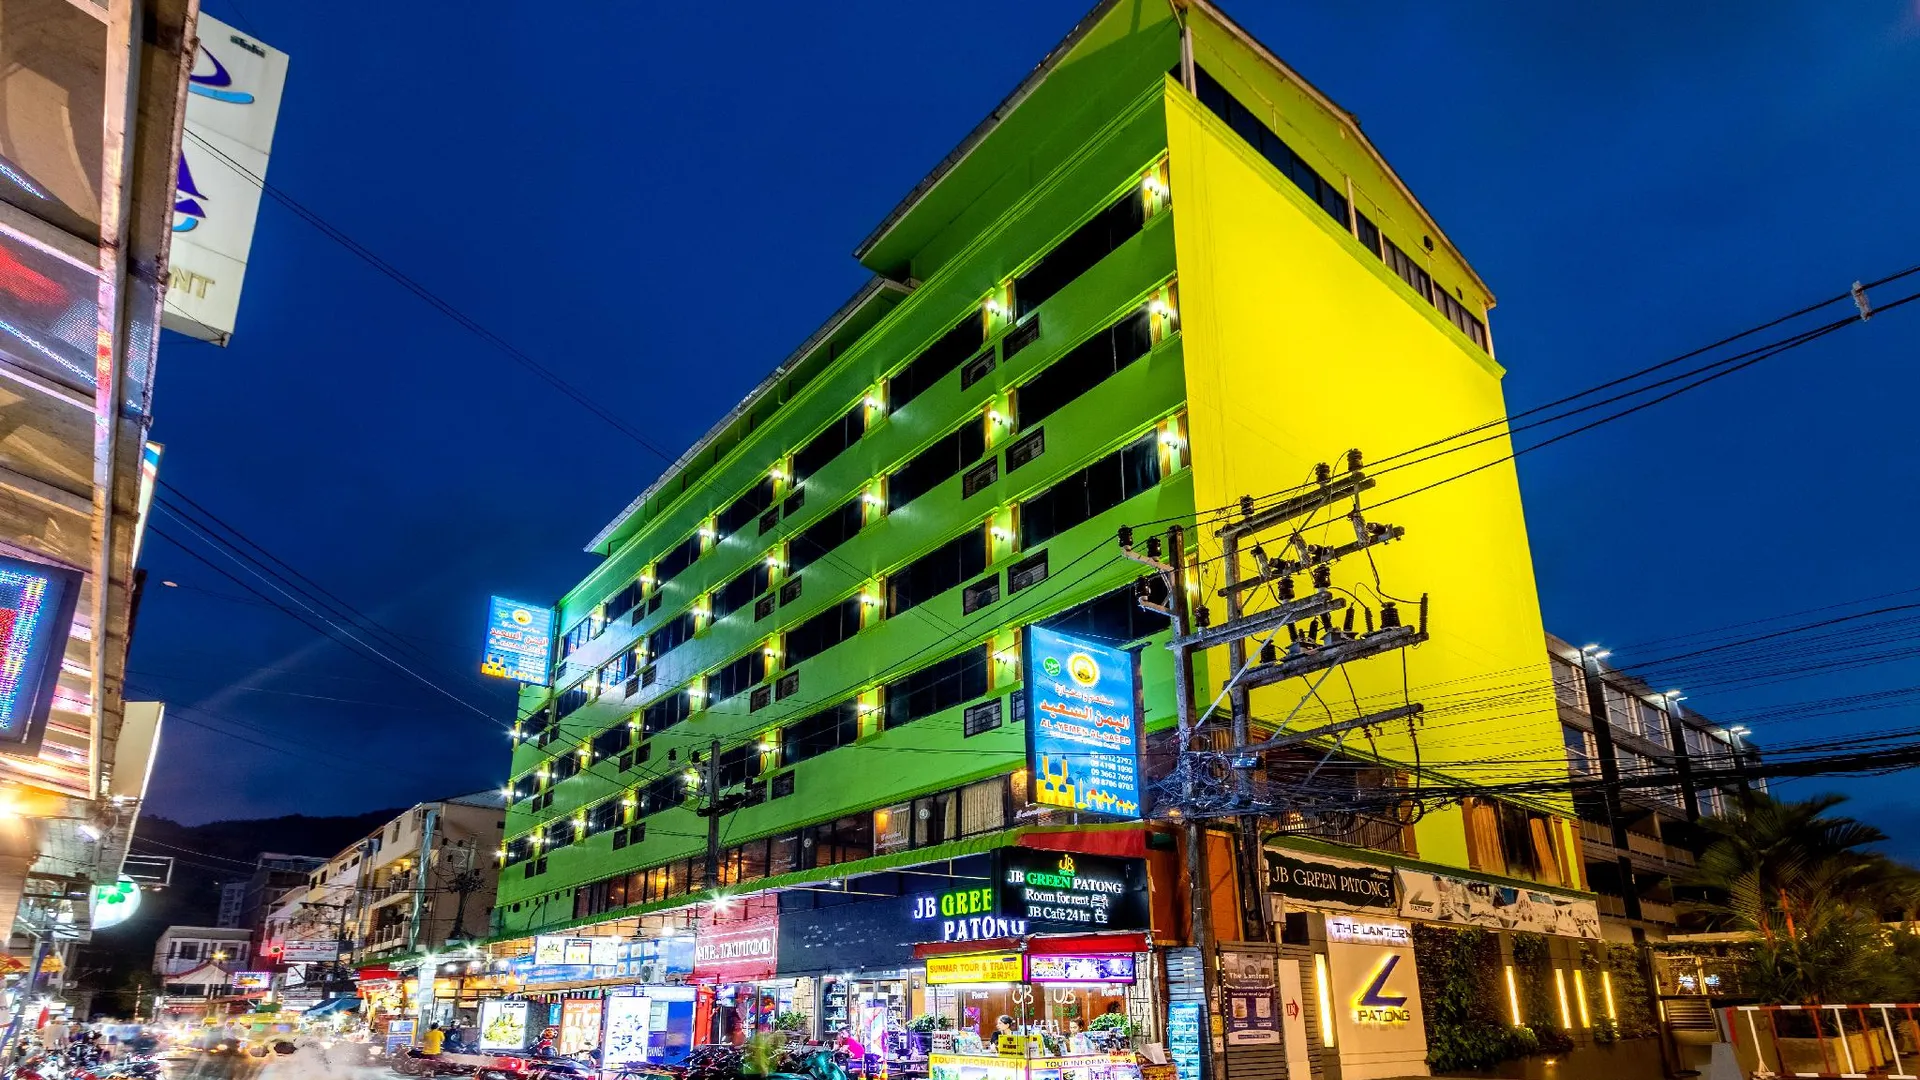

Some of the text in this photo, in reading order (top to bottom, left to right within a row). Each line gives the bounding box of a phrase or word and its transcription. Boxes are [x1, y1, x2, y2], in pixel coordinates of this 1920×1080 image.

[1040, 699, 1130, 733] اليمن السعيد
[1008, 870, 1122, 894] JB GREEN PATONG
[1272, 866, 1390, 898] JB GREEN PATONG
[914, 888, 992, 919] JB GREE
[1025, 888, 1089, 906] Room for rent
[1028, 905, 1090, 922] JB Café 24 hr
[1410, 904, 1434, 914] PATONG
[1333, 922, 1413, 939] THE LANTERN
[960, 962, 979, 972] TOUR
[990, 962, 1018, 971] TRAVEL
[1244, 971, 1269, 979] Lantern
[1357, 1009, 1410, 1022] PATONG
[934, 1056, 1023, 1069] TOUR INFORMATION
[1045, 1060, 1069, 1068] TOUR
